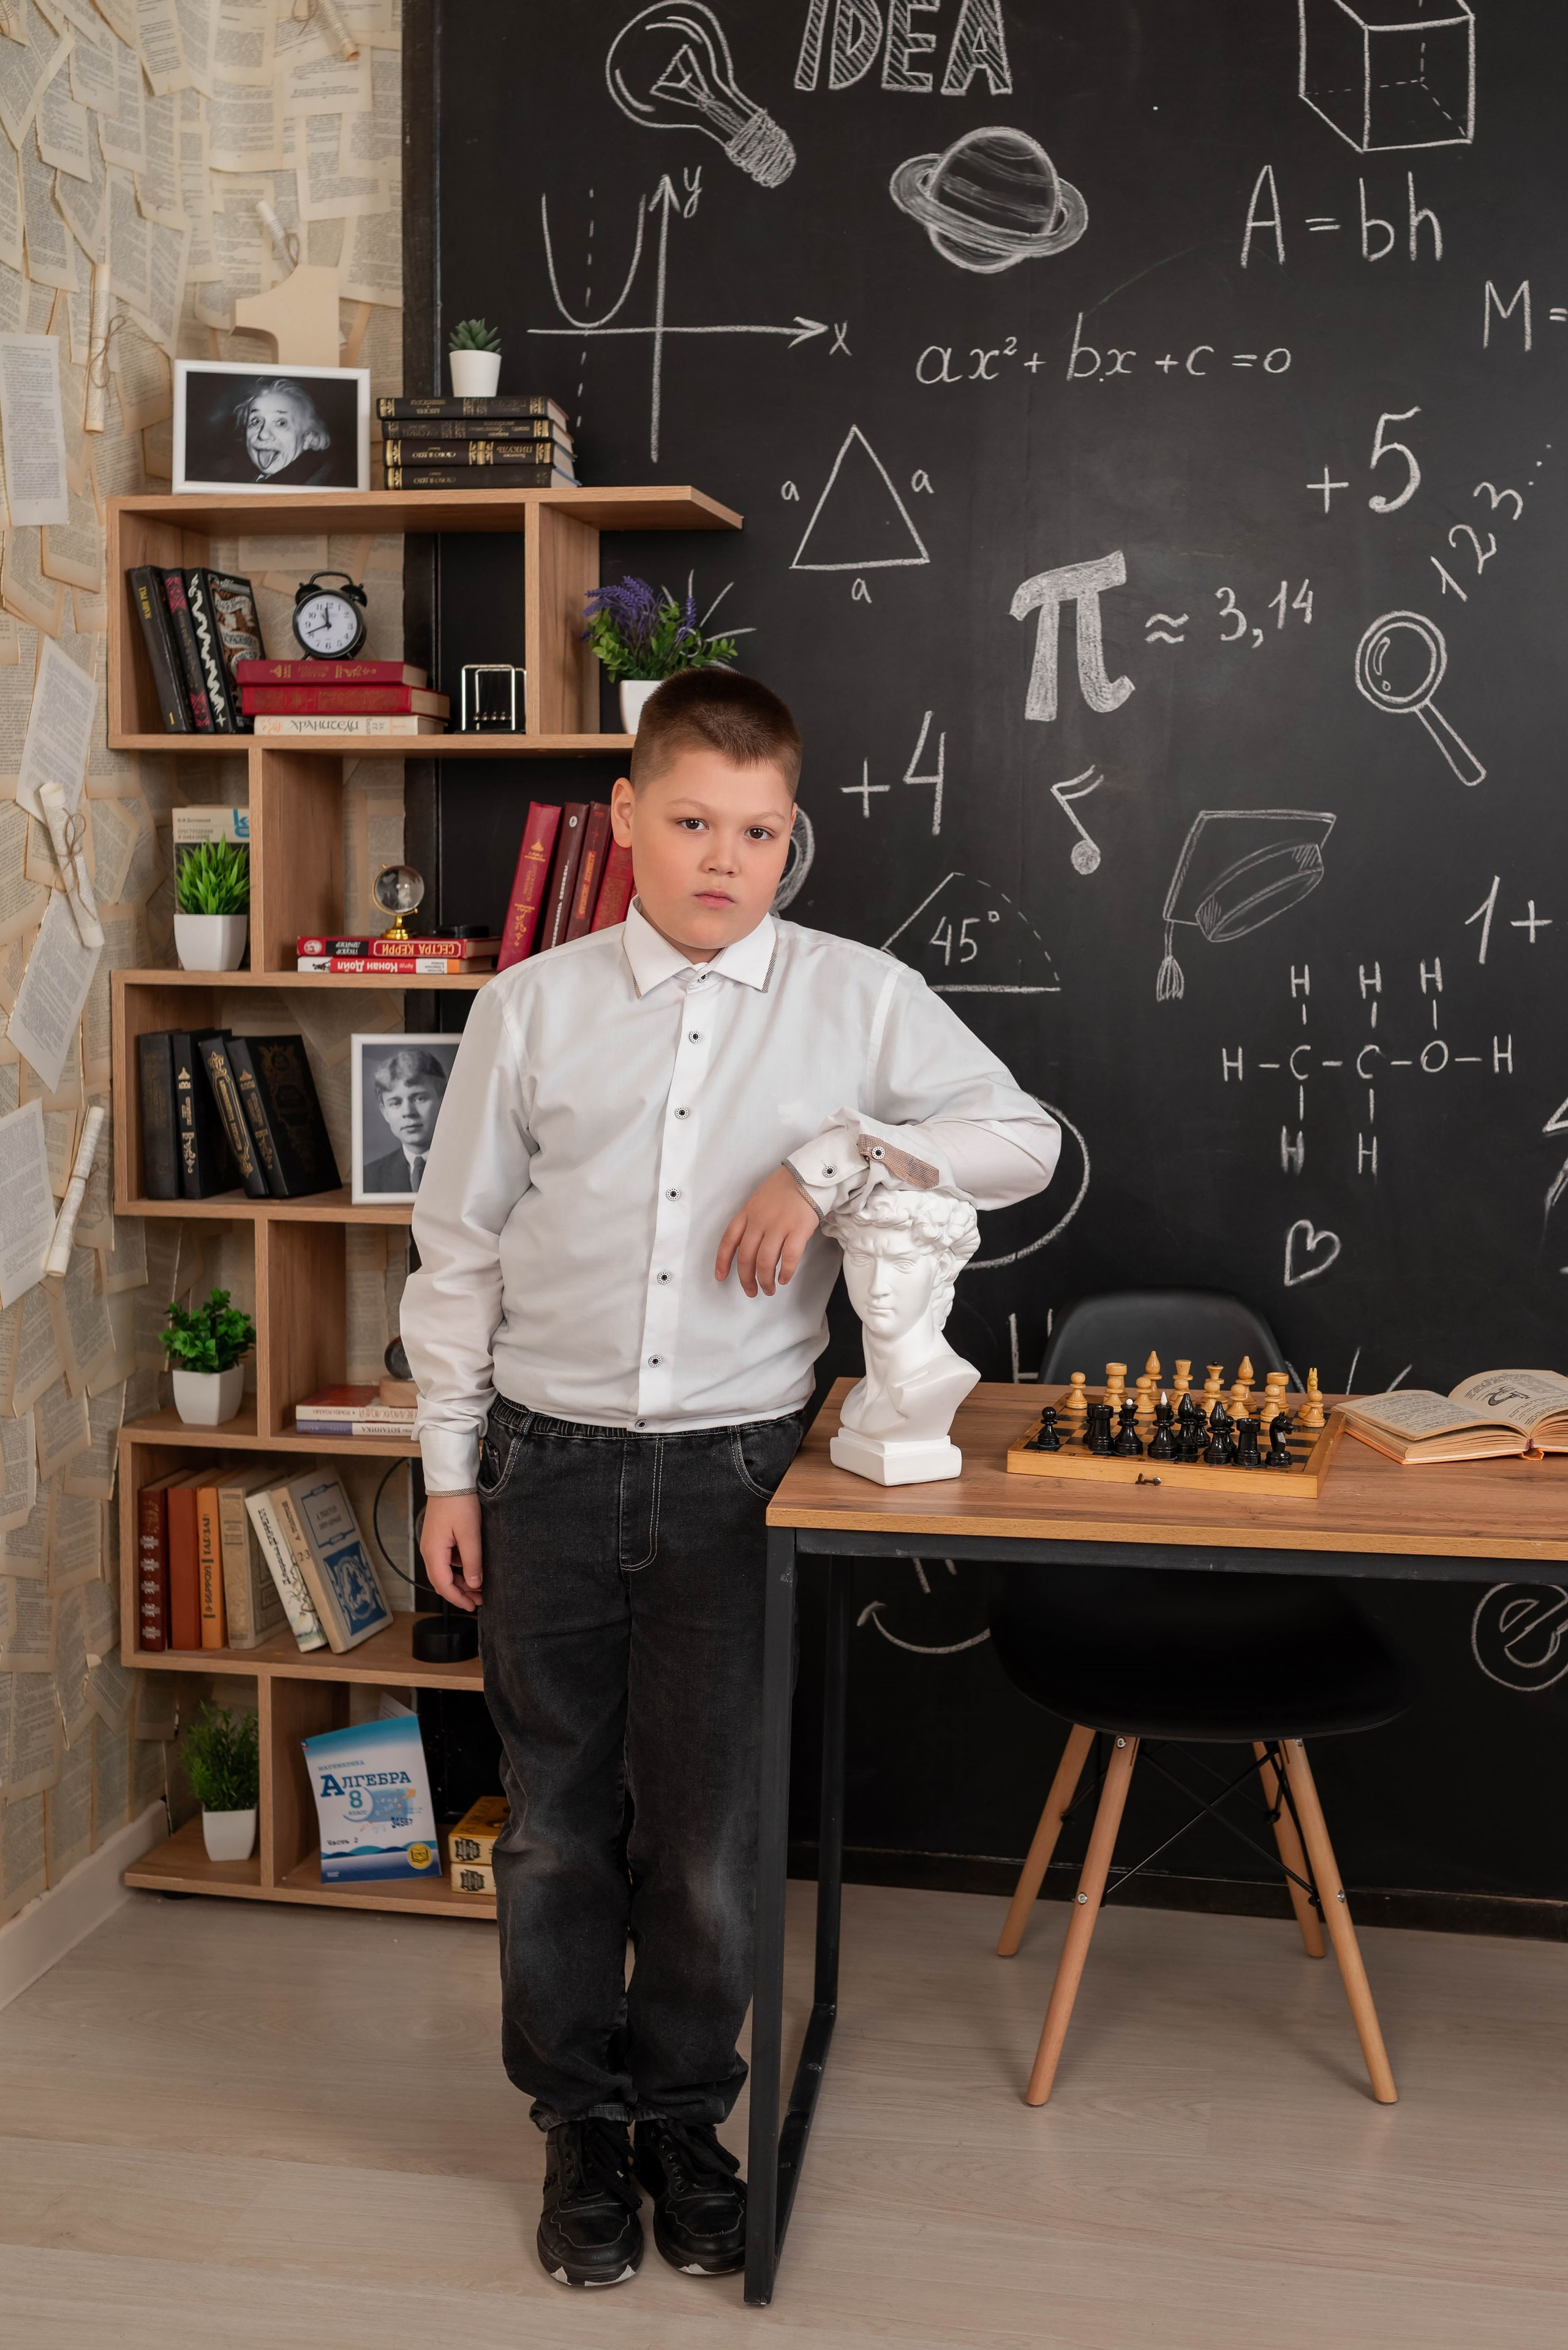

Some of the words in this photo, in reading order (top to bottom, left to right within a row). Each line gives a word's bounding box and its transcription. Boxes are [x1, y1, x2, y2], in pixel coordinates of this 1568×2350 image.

[794, 0, 1012, 96] IDEA
[1240, 164, 1286, 269] A
[496, 445, 533, 454] ПИКУЛЬ
[1215, 578, 1314, 649] 3,14
[382, 943, 415, 956] КЕРРИ
[418, 943, 455, 955] СЕСТРА
[337, 959, 364, 973] Дойл
[366, 961, 398, 973] Конан
[361, 1425, 401, 1434] БОТАНИКА
[201, 1513, 211, 1556] ТАРЗАН
[320, 1771, 412, 1798] АЛГЕБРА
[349, 1790, 363, 1809] 8
